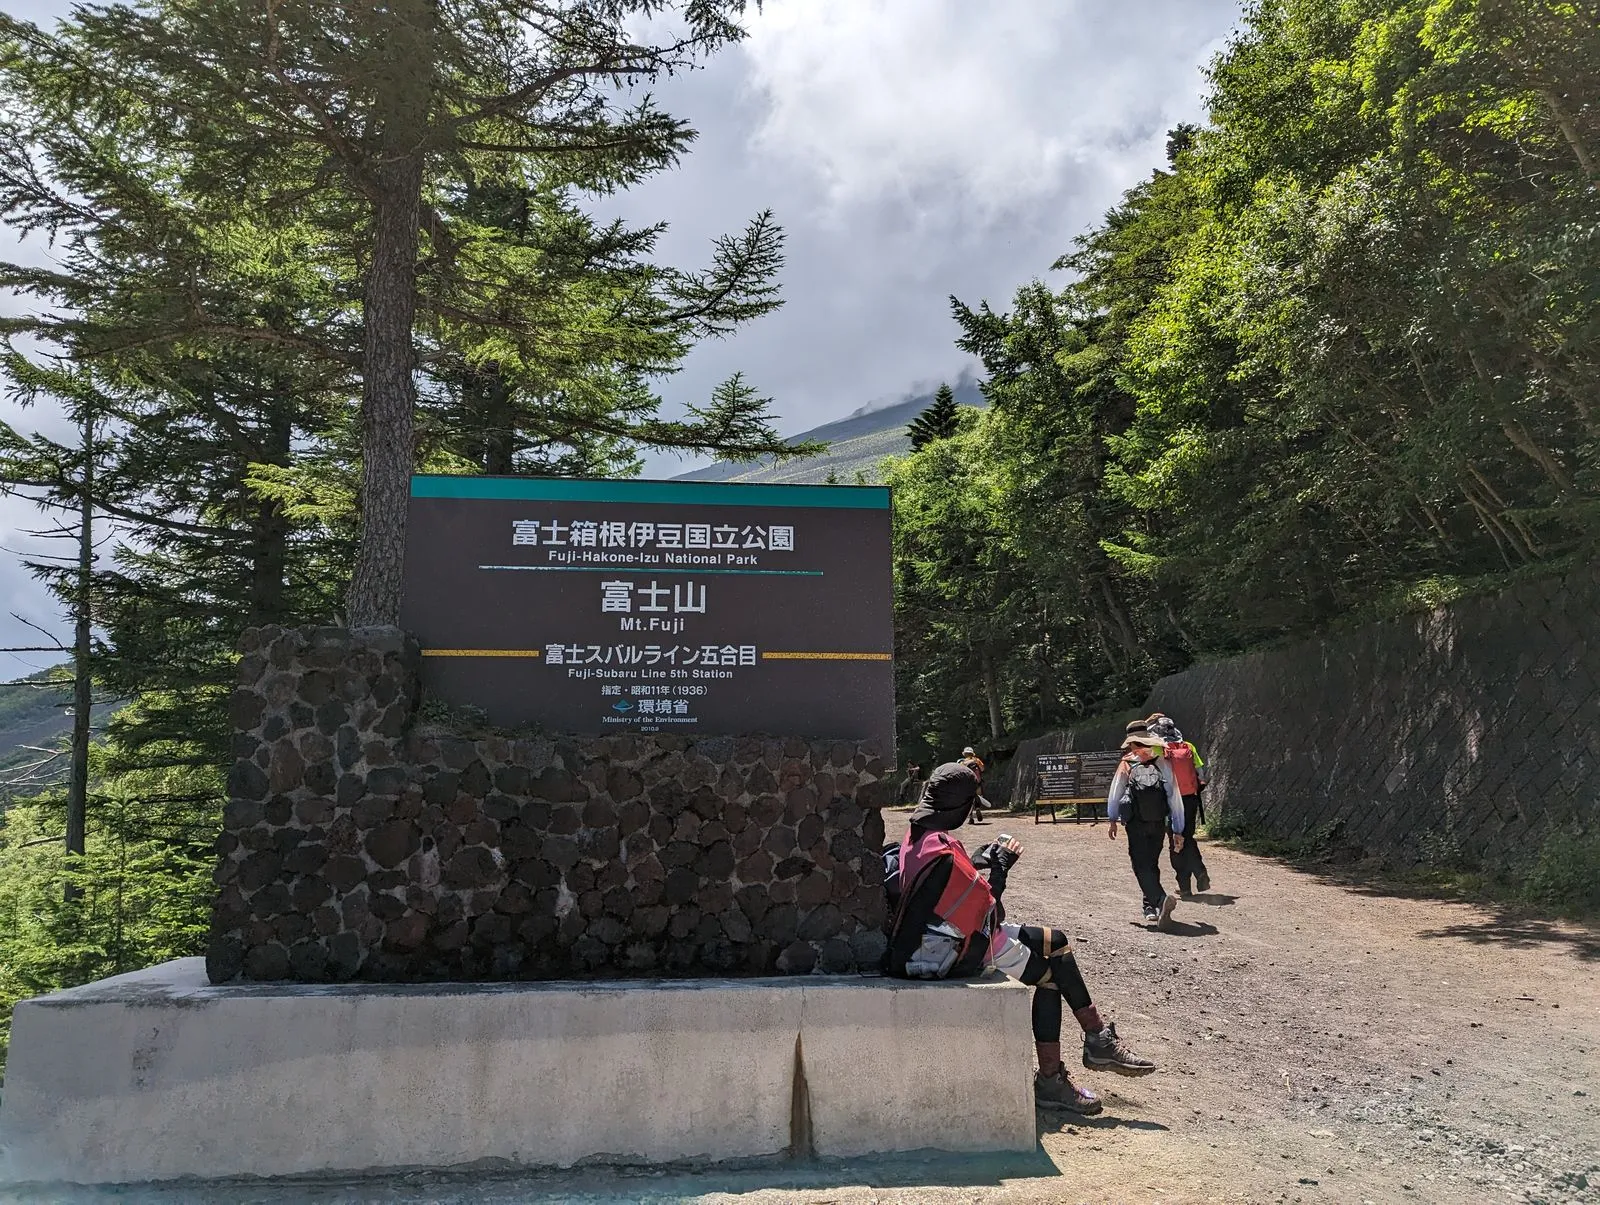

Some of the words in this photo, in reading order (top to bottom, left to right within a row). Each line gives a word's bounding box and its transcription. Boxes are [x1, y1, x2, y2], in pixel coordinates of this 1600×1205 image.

[512, 519, 794, 552] 富士箱根伊豆国立公園
[548, 550, 660, 564] Fuji-Hakone-Izu
[665, 553, 721, 565] National
[727, 554, 758, 565] Park
[600, 579, 706, 614] 富士山
[620, 617, 684, 634] Mt.Fuji
[545, 643, 756, 666] 富士スバルライン五合目
[568, 668, 637, 680] Fuji-Subaru
[641, 669, 667, 679] Line
[669, 669, 688, 679] 5th
[691, 669, 733, 680] Station
[637, 699, 690, 714] 環境省
[602, 716, 632, 725] Ministry
